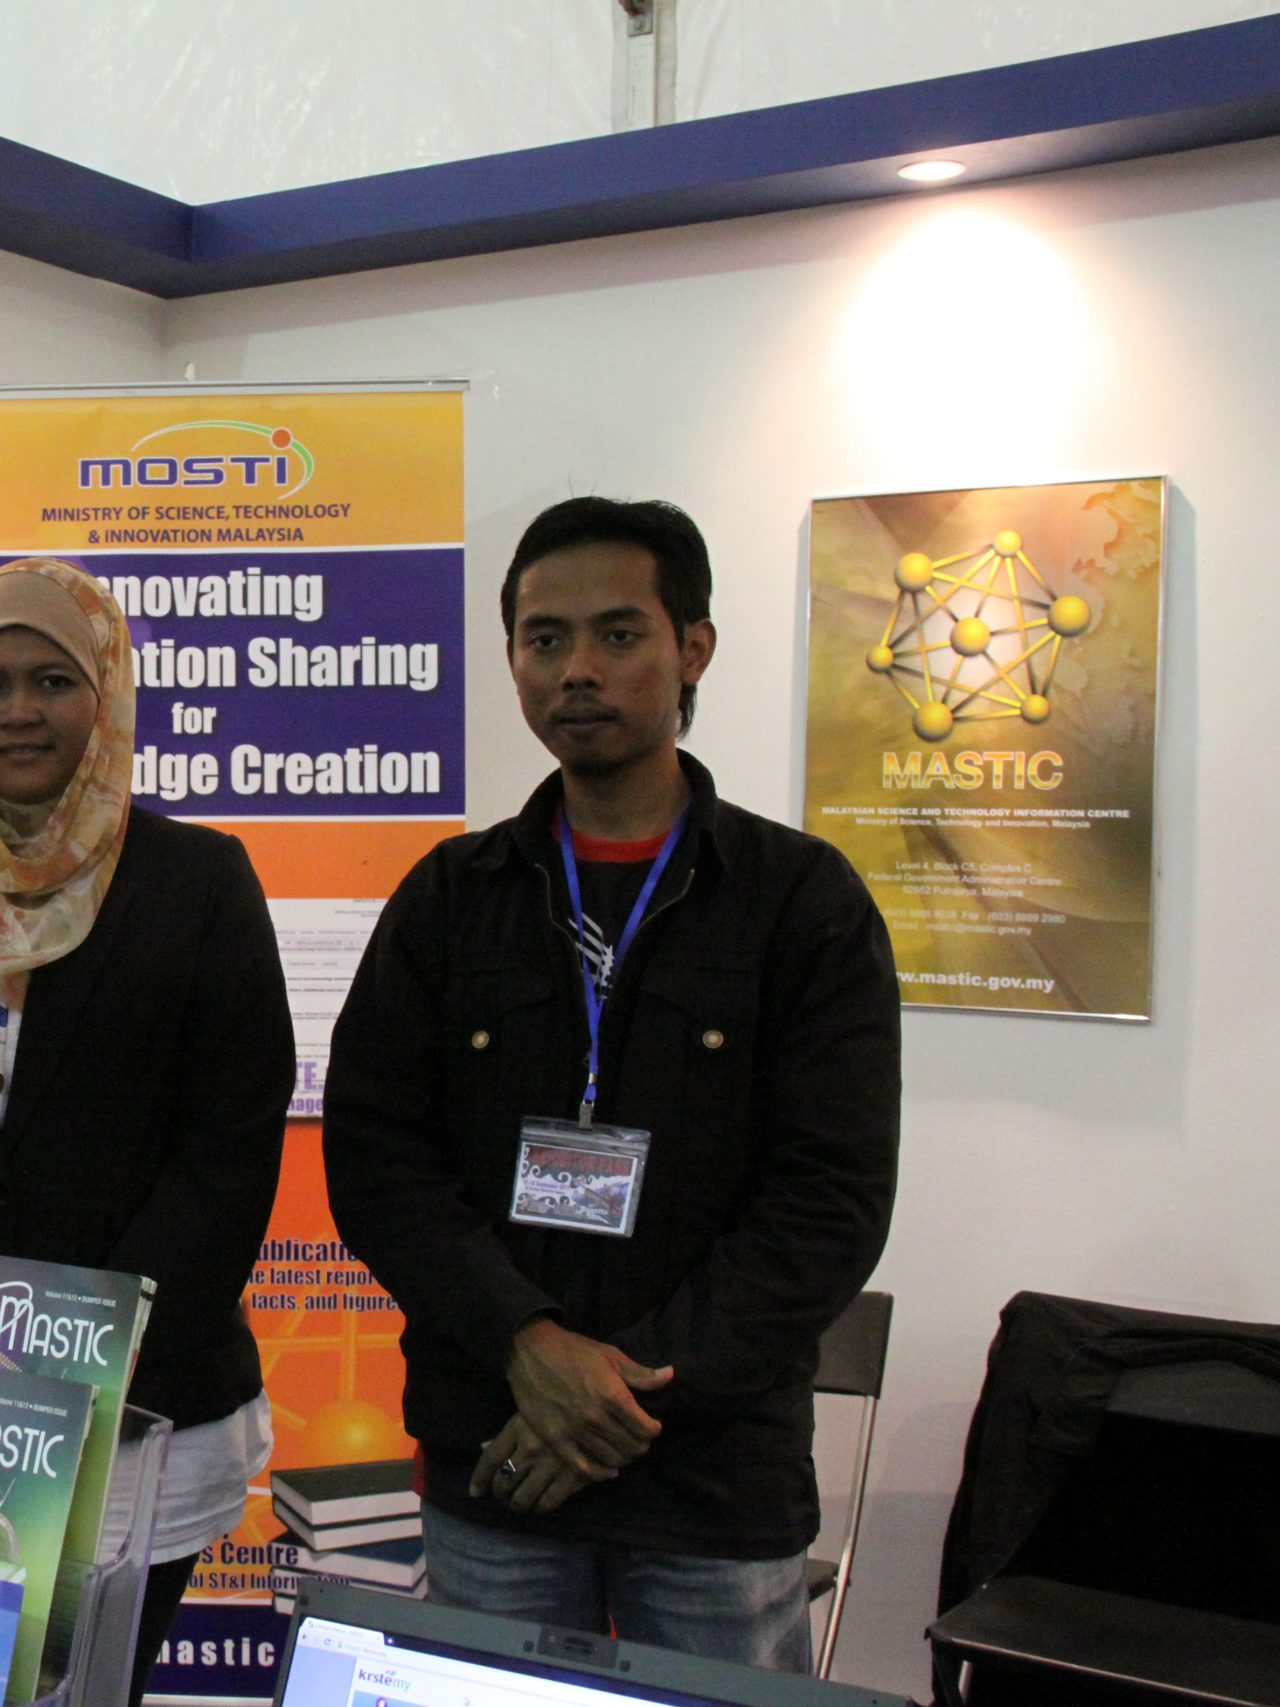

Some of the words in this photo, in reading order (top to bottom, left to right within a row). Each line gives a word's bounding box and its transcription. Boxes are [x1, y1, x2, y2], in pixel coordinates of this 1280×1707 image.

[41, 507, 123, 522] MINISTRY
[127, 506, 150, 520] OF
[155, 504, 229, 522] SCIENCE,
[233, 503, 351, 519] TECHNOLOGY
[87, 529, 100, 543] &
[104, 528, 212, 543] INNOVATION
[216, 526, 304, 542] MALAYSIA
[247, 636, 438, 692] Sharing
[171, 702, 217, 734] for
[230, 744, 440, 796] Creation
[882, 750, 1064, 790] MASTIC
[878, 807, 918, 815] SCIENCE
[921, 807, 941, 816] AND
[944, 808, 1010, 817] TECHNOLOGY
[1014, 809, 1085, 818] INFORMATION
[1087, 810, 1130, 818] CENTRE
[270, 1268, 321, 1285] latest
[305, 1293, 337, 1310] and
[343, 1293, 397, 1312] figure
[221, 1542, 298, 1565] Centre
